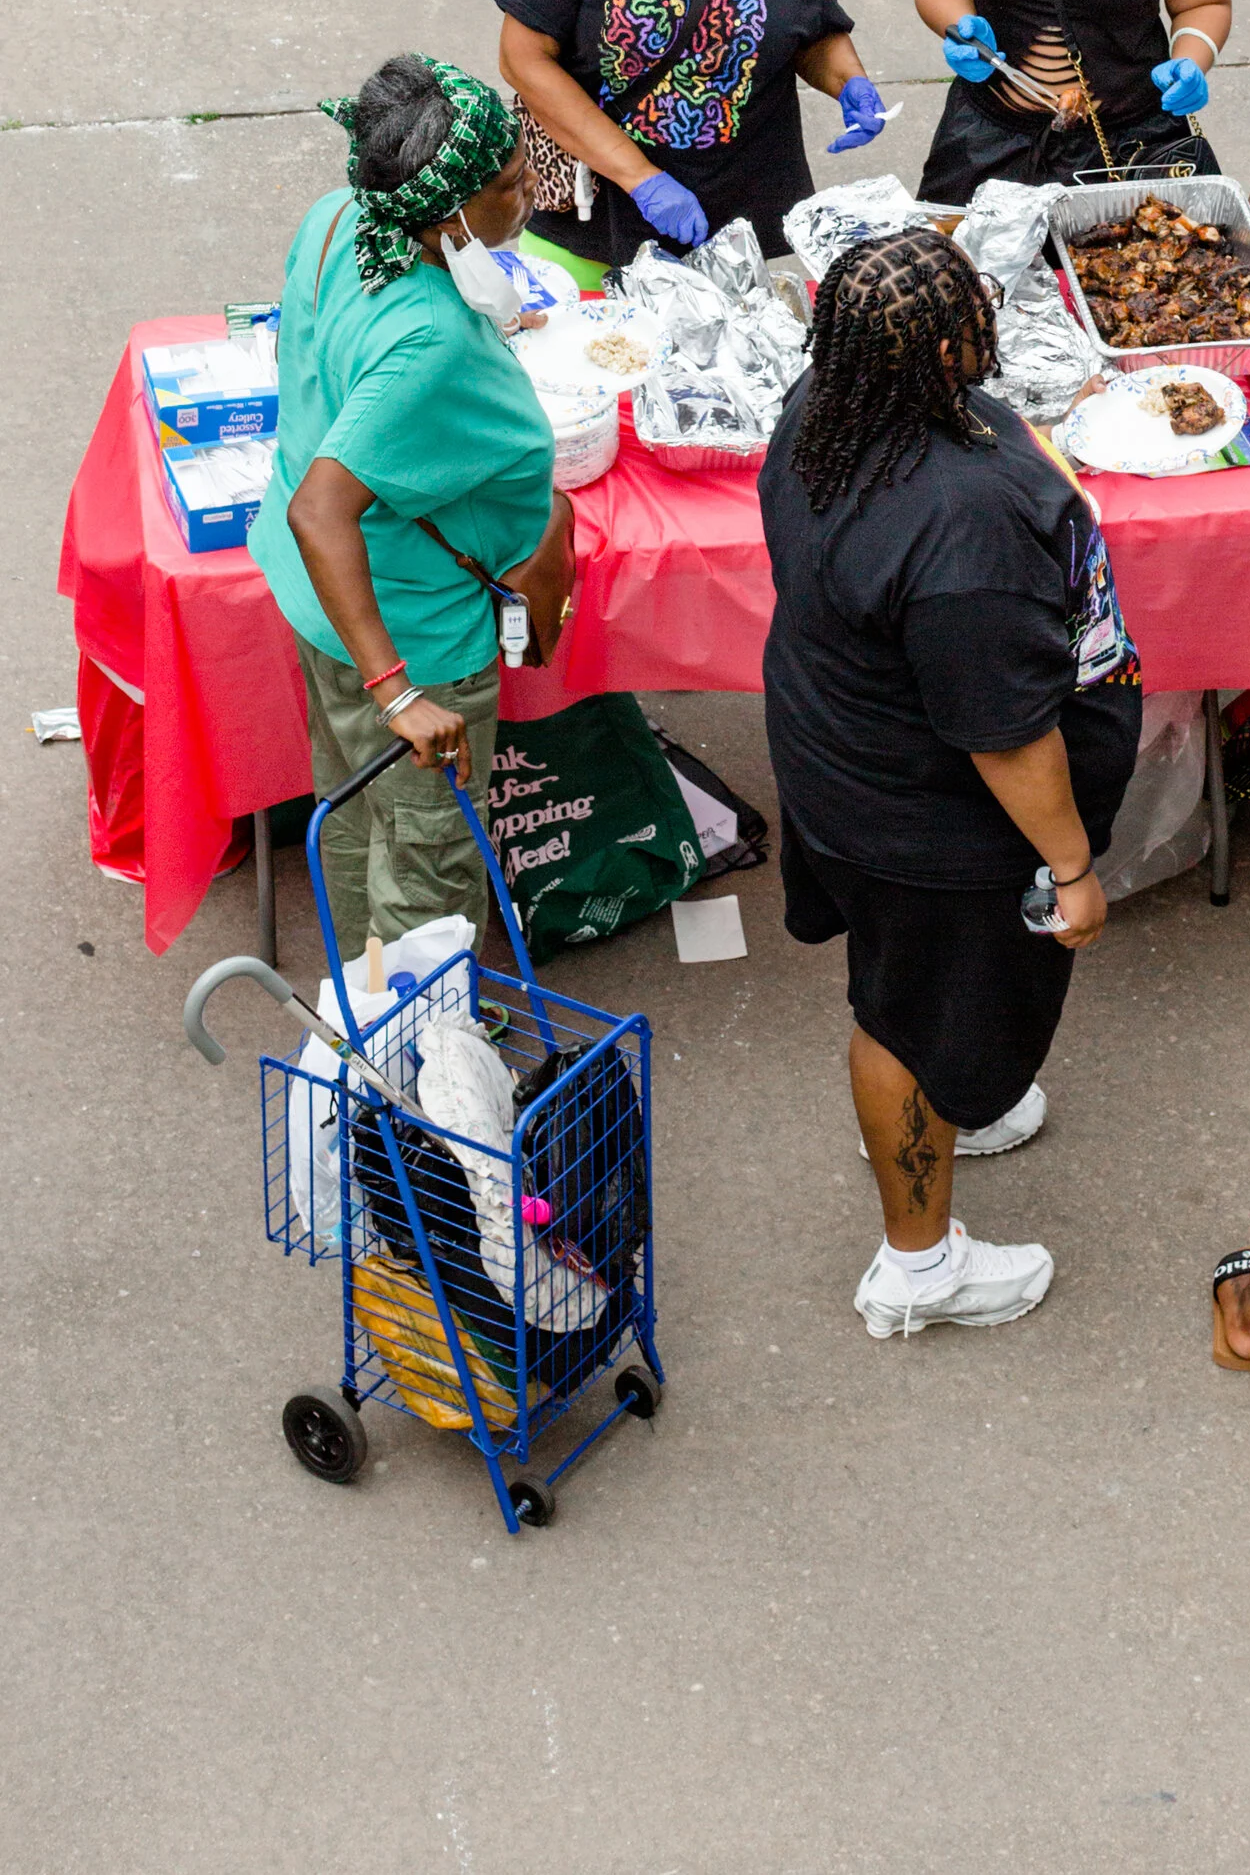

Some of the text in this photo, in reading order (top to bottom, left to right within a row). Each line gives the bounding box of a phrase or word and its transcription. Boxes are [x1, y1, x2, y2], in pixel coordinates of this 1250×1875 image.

[228, 412, 263, 423] Cutlery
[219, 423, 263, 435] Assorted
[491, 775, 560, 808] for
